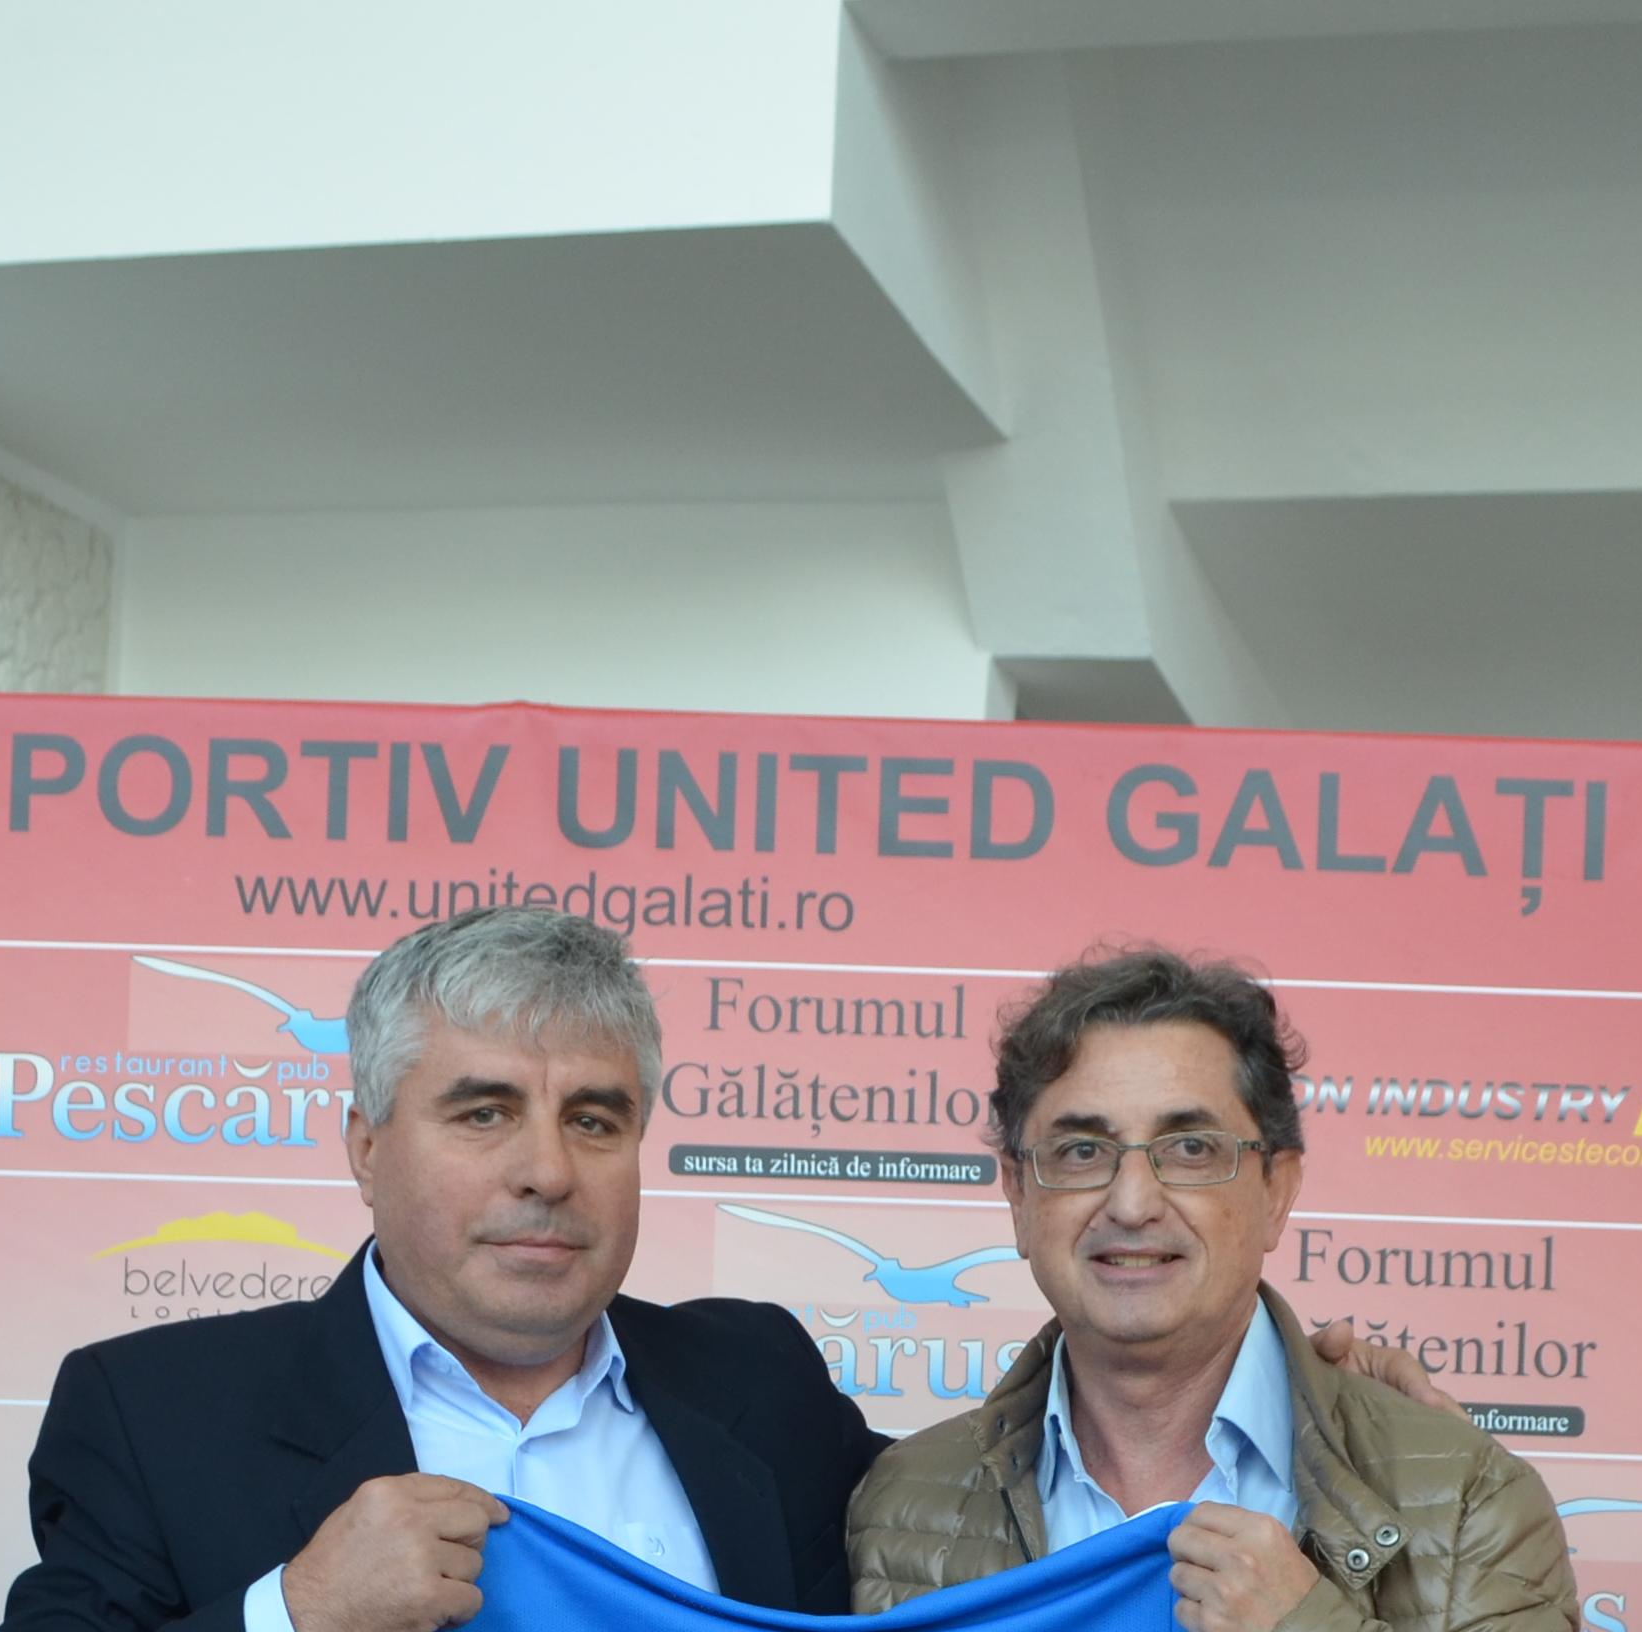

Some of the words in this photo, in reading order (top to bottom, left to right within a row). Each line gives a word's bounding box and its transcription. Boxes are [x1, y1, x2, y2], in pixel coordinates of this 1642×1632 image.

[557, 745, 1055, 861] UNITED
[1104, 762, 1606, 916] GALAȚI
[234, 867, 856, 934] www.unitedgalati.ro
[703, 976, 968, 1041] Forumul
[60, 1052, 229, 1077] restaurant
[277, 1052, 330, 1088] pub
[1364, 1076, 1631, 1125] INDUSTRY
[683, 1155, 739, 1173] sursa
[744, 1155, 764, 1175] ta
[769, 1152, 840, 1177] zilnică
[845, 1155, 872, 1178] de
[877, 1156, 982, 1181] informare
[123, 1257, 332, 1302] belvedere
[1294, 1227, 1556, 1293] Forumul
[863, 1304, 917, 1333] pub
